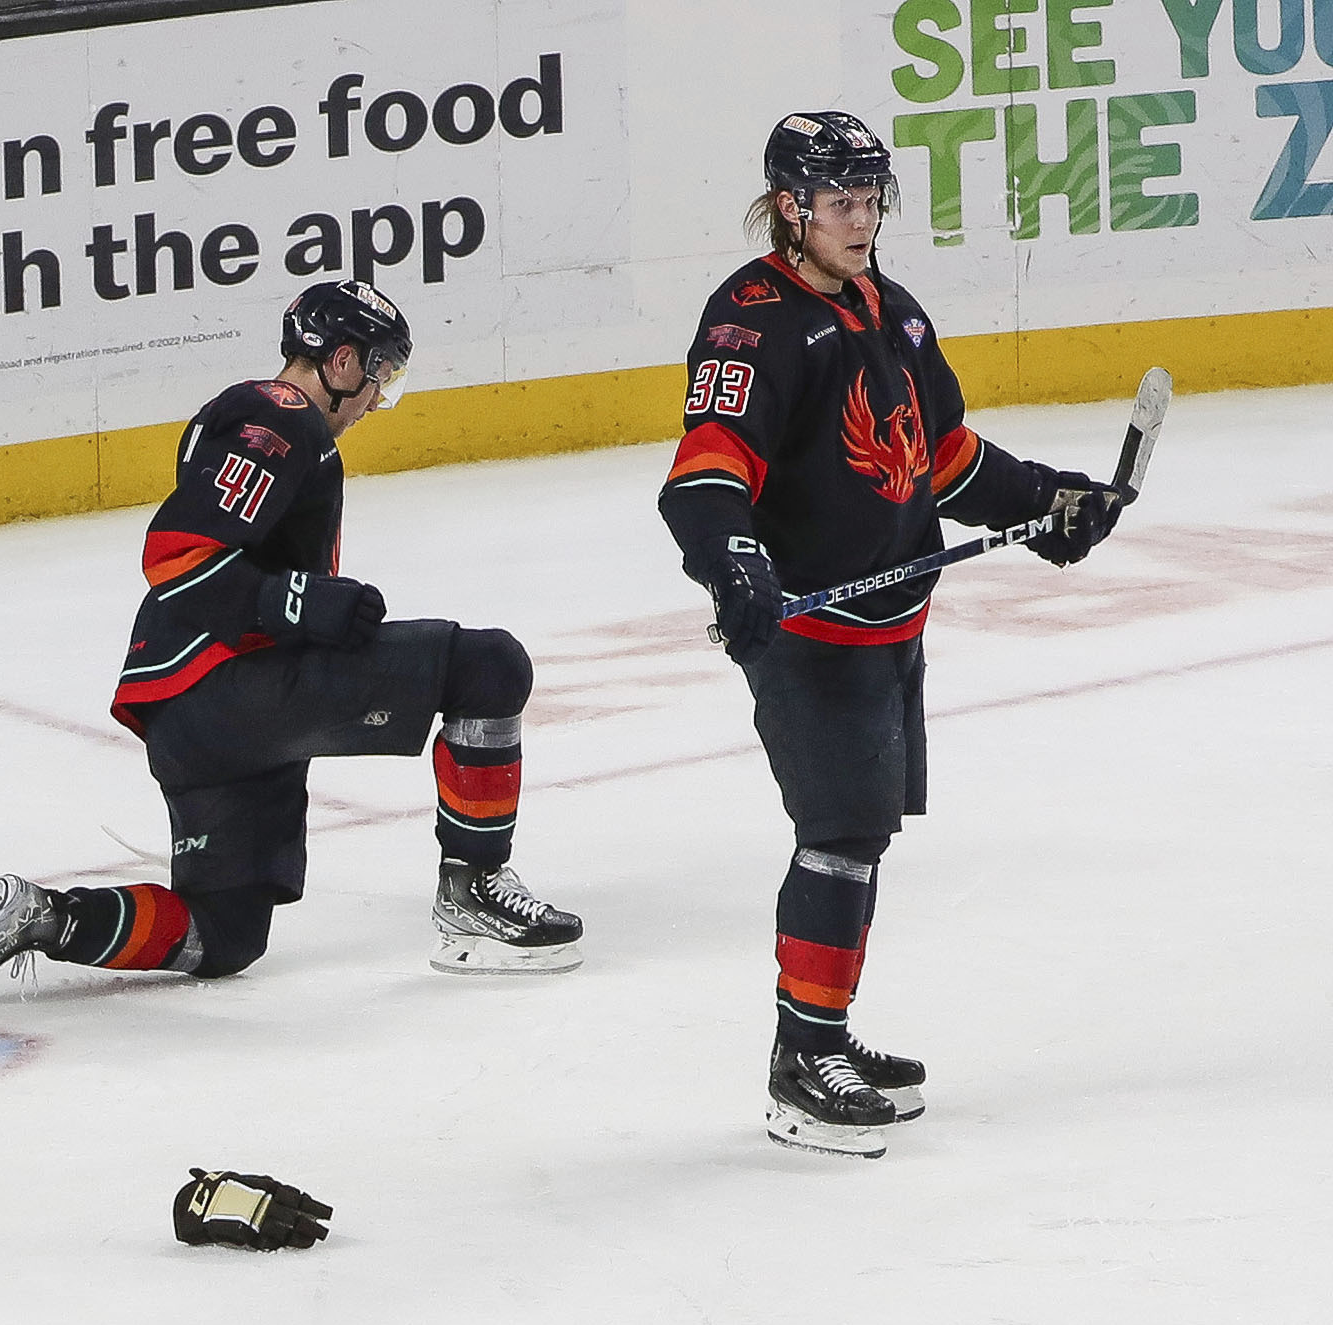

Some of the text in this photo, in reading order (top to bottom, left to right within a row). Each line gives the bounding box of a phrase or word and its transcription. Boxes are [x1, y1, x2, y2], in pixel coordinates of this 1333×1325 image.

[891, 0, 1116, 103] SEE
[85, 102, 297, 188] free
[319, 52, 565, 159] food
[893, 90, 1200, 247] THE
[85, 212, 261, 301] the
[283, 195, 486, 286] app
[23, 356, 42, 367] and
[44, 347, 100, 364] registration
[685, 359, 754, 417] 33
[214, 452, 275, 524] 41
[825, 568, 905, 605] JETSPEED
[982, 514, 1054, 552] CCM
